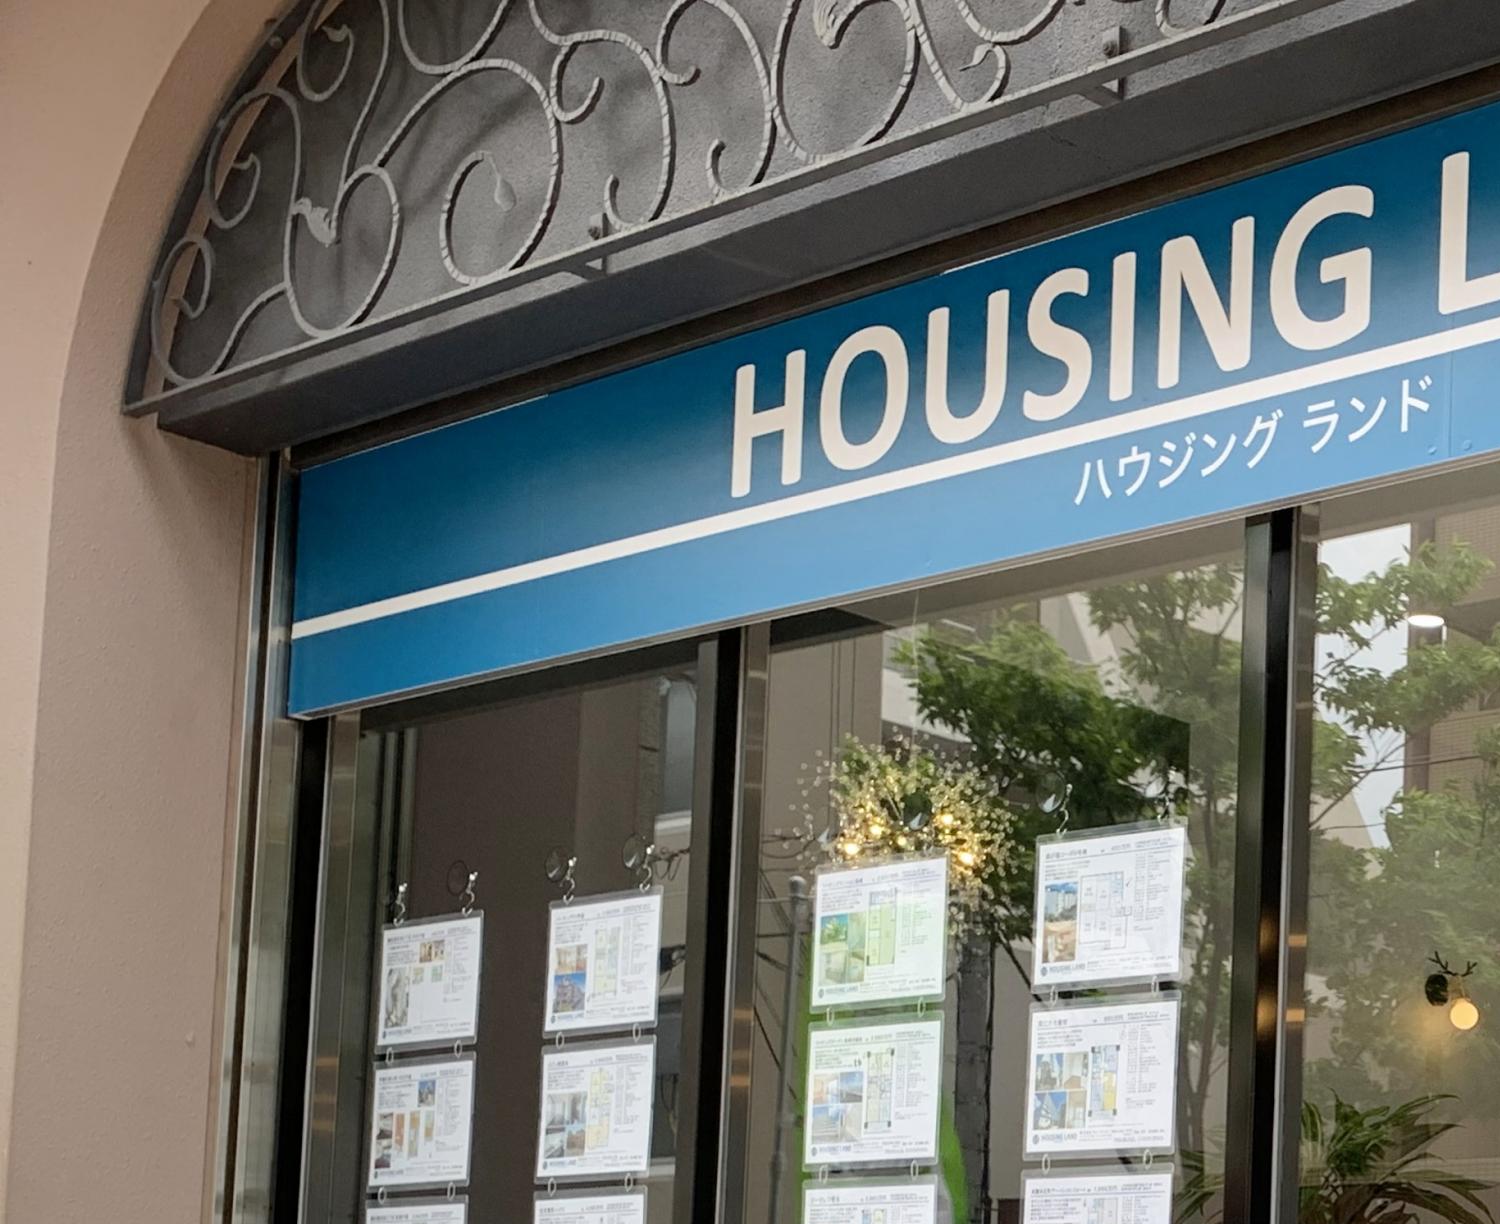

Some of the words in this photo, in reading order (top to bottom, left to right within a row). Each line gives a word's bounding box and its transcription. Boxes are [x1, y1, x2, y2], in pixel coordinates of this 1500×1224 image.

[730, 184, 1375, 499] HOUSING
[1073, 407, 1285, 506] ハウジング
[1300, 376, 1432, 455] ランド
